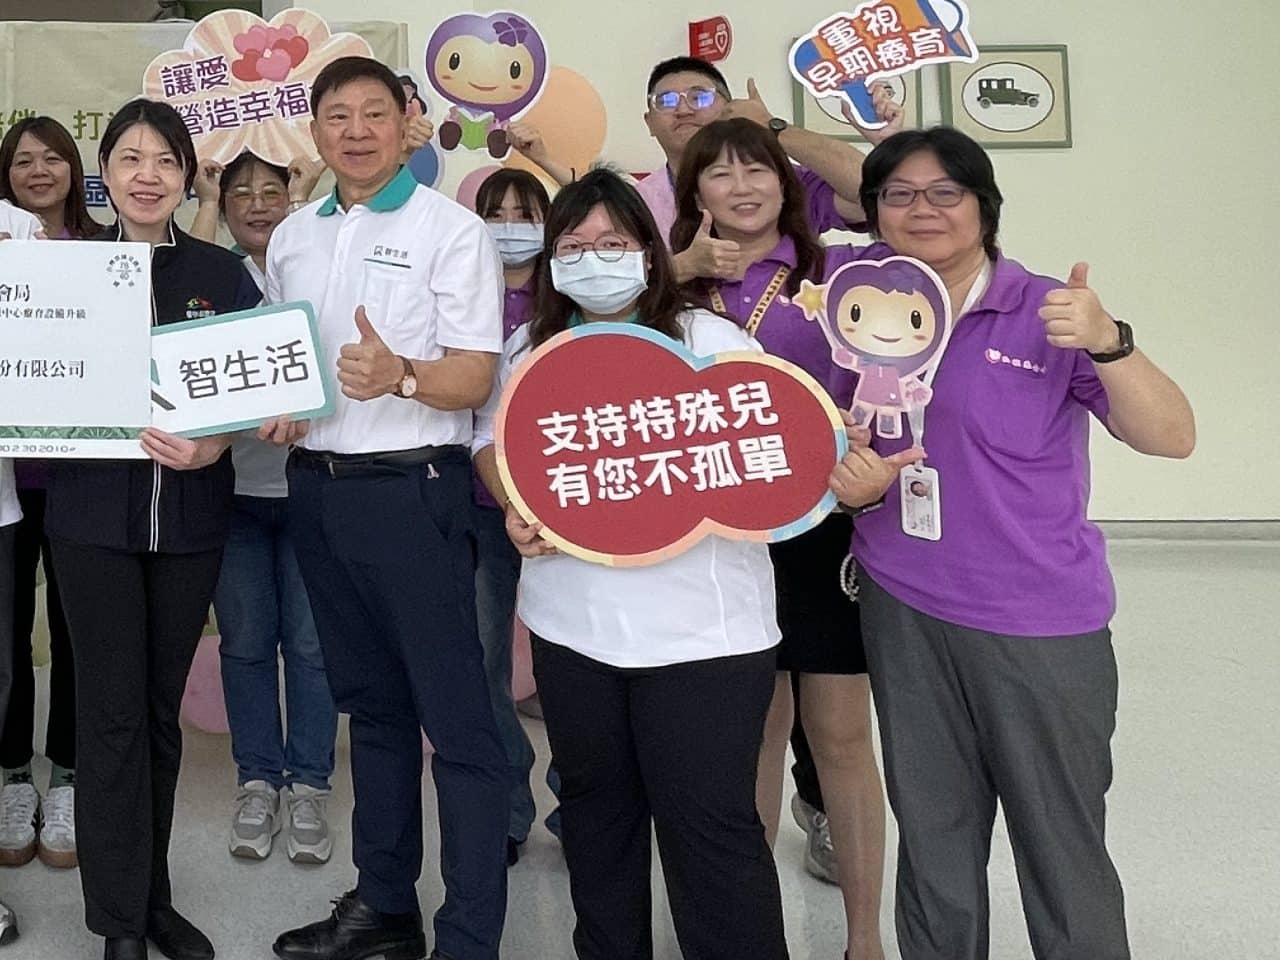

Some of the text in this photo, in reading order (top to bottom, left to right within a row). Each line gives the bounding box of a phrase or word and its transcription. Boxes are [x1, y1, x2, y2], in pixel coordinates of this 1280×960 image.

[808, 28, 945, 89] 早期療育
[822, 6, 901, 54] 重視
[161, 56, 229, 97] 讓愛
[173, 83, 312, 135] 營造幸福
[179, 339, 309, 399] 智生活
[537, 381, 779, 456] 支持特殊兒
[546, 434, 792, 508] 有您不孤單
